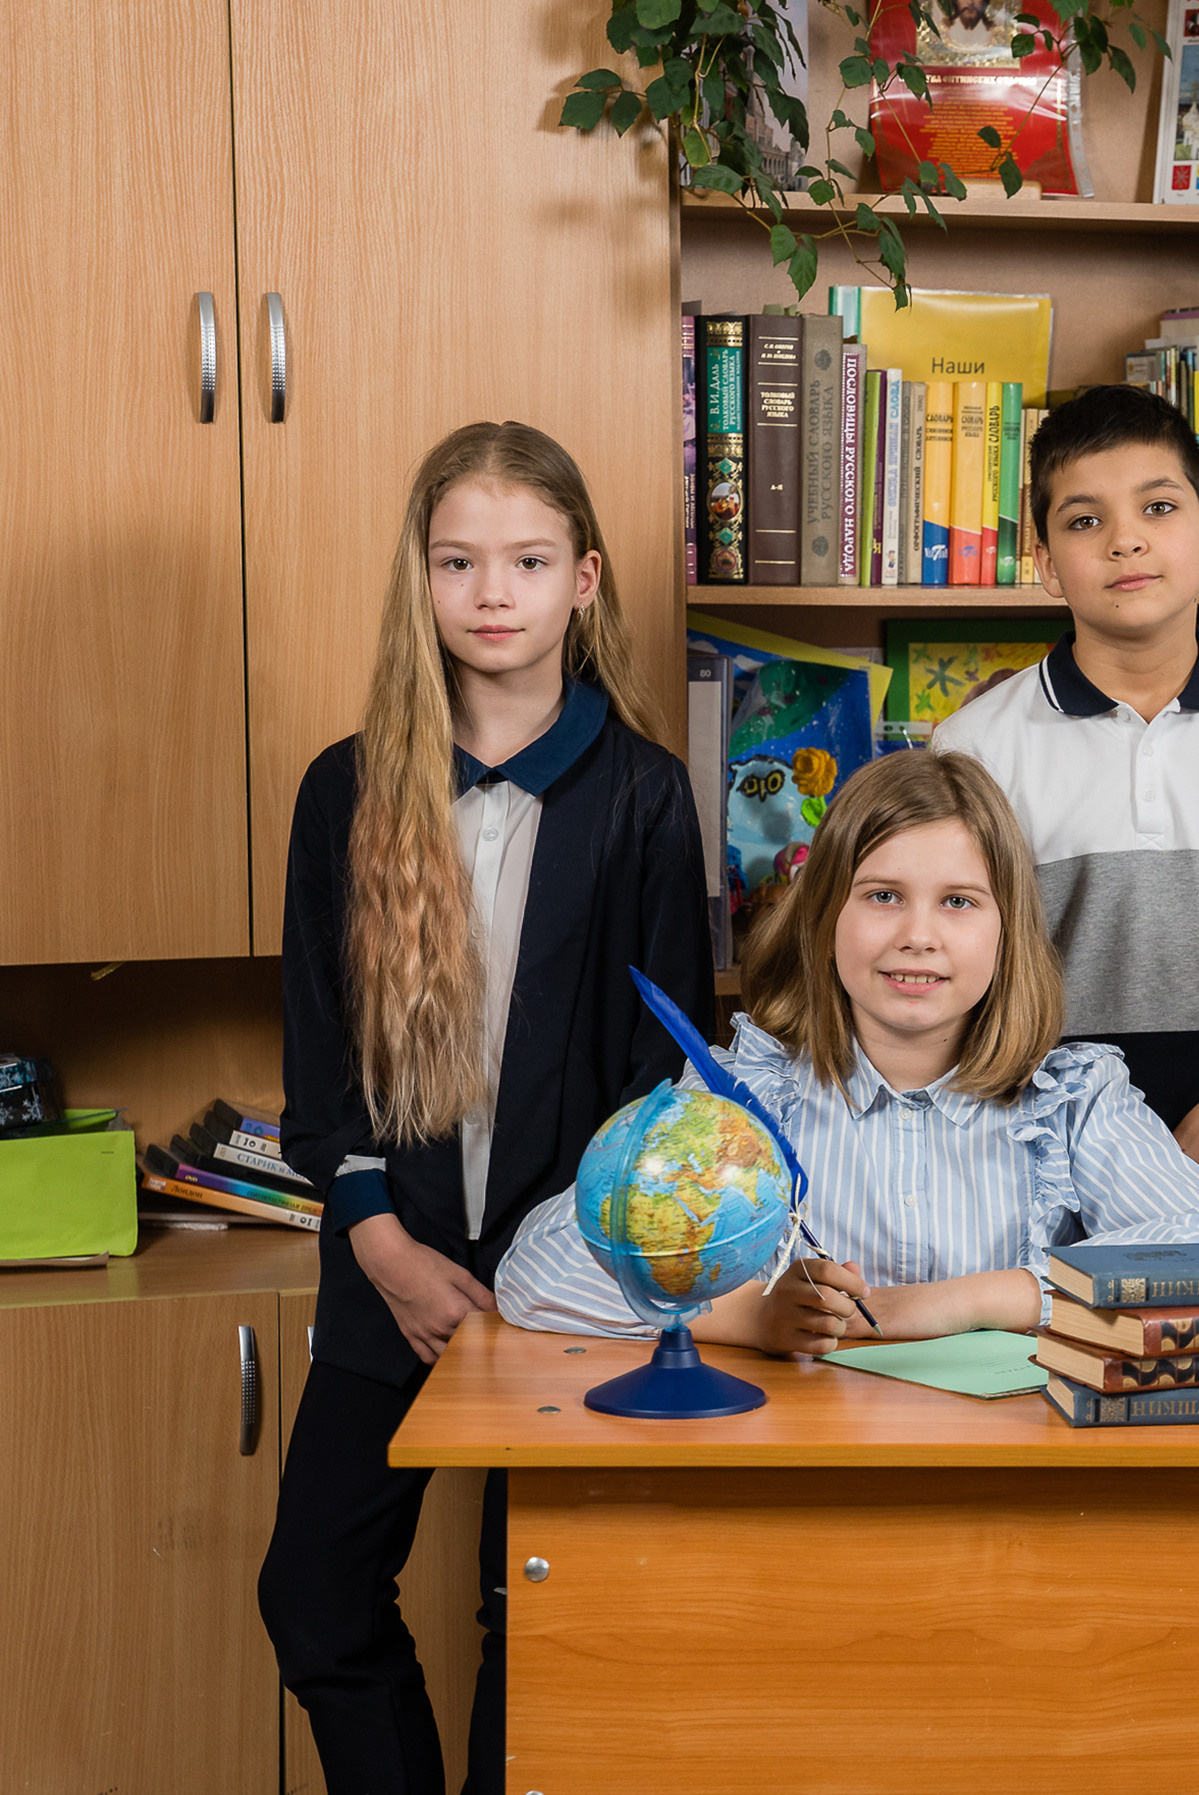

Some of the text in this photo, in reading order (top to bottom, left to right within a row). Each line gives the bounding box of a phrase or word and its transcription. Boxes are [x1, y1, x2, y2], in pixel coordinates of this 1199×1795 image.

[931, 357, 985, 375] Наши
[721, 349, 730, 431] ТОЛКОВЫЙ СЛОВАРЬ
[728, 355, 737, 426] РУССКОГО ЯЗЫКА
[760, 391, 796, 400] ТОЛКОВЫЙ
[763, 398, 793, 406] СЛОВАРЬ
[889, 380, 900, 419] СЛОВА
[988, 404, 1000, 443] СЛОВАРЬ
[806, 379, 821, 526] УЧЕБНЫЙ СЛОВАРЬ
[821, 386, 835, 521] РУССКОГО ЯЗЫКА
[842, 357, 858, 573] ПОСЛОВИЦЫ РУССКОГО НАРОДА
[913, 425, 923, 552] ОРФОГРАФИЧЕСКИЙ СЛОВАРЬ
[236, 1152, 276, 1174] СТАРИК
[171, 1184, 203, 1199] Лондон
